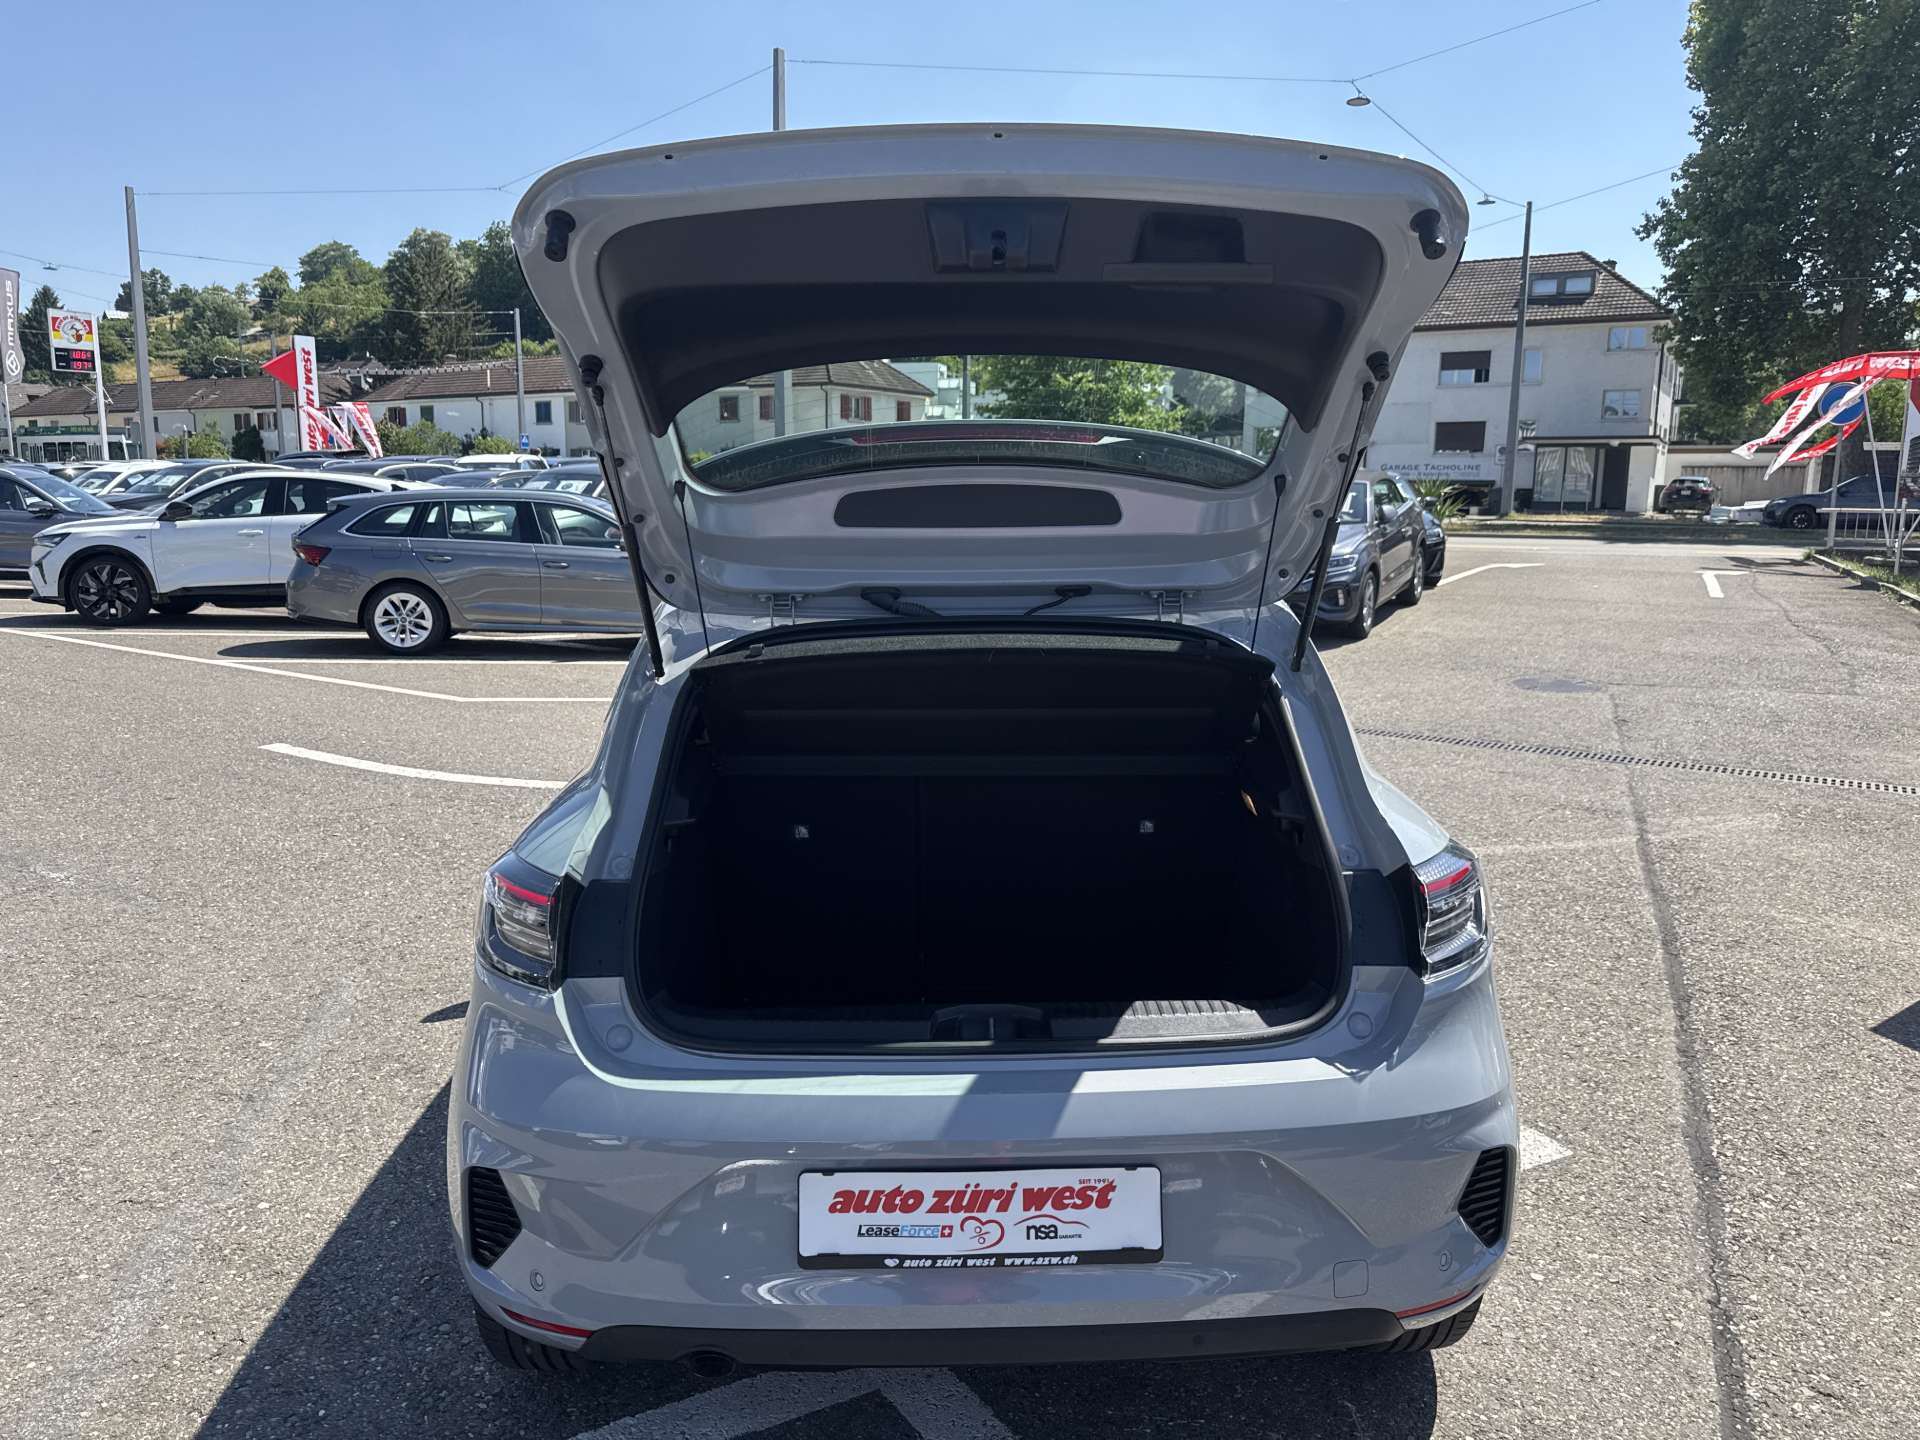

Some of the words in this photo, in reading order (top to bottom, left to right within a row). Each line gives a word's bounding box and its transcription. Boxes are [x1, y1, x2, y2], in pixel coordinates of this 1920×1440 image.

[5, 279, 14, 346] MAXUS
[301, 347, 313, 386] west
[1380, 463, 1420, 471] GARAGE
[1424, 463, 1481, 471] TACHOLINE
[828, 1184, 925, 1214] auto
[925, 1182, 1018, 1214] züri
[1022, 1179, 1117, 1212] west
[857, 1224, 940, 1238] LeaseForce
[1026, 1224, 1058, 1240] nsa
[903, 1258, 932, 1268] auto
[935, 1256, 963, 1268] züri
[966, 1257, 996, 1267] west
[1004, 1254, 1079, 1266] www.azw.ch
